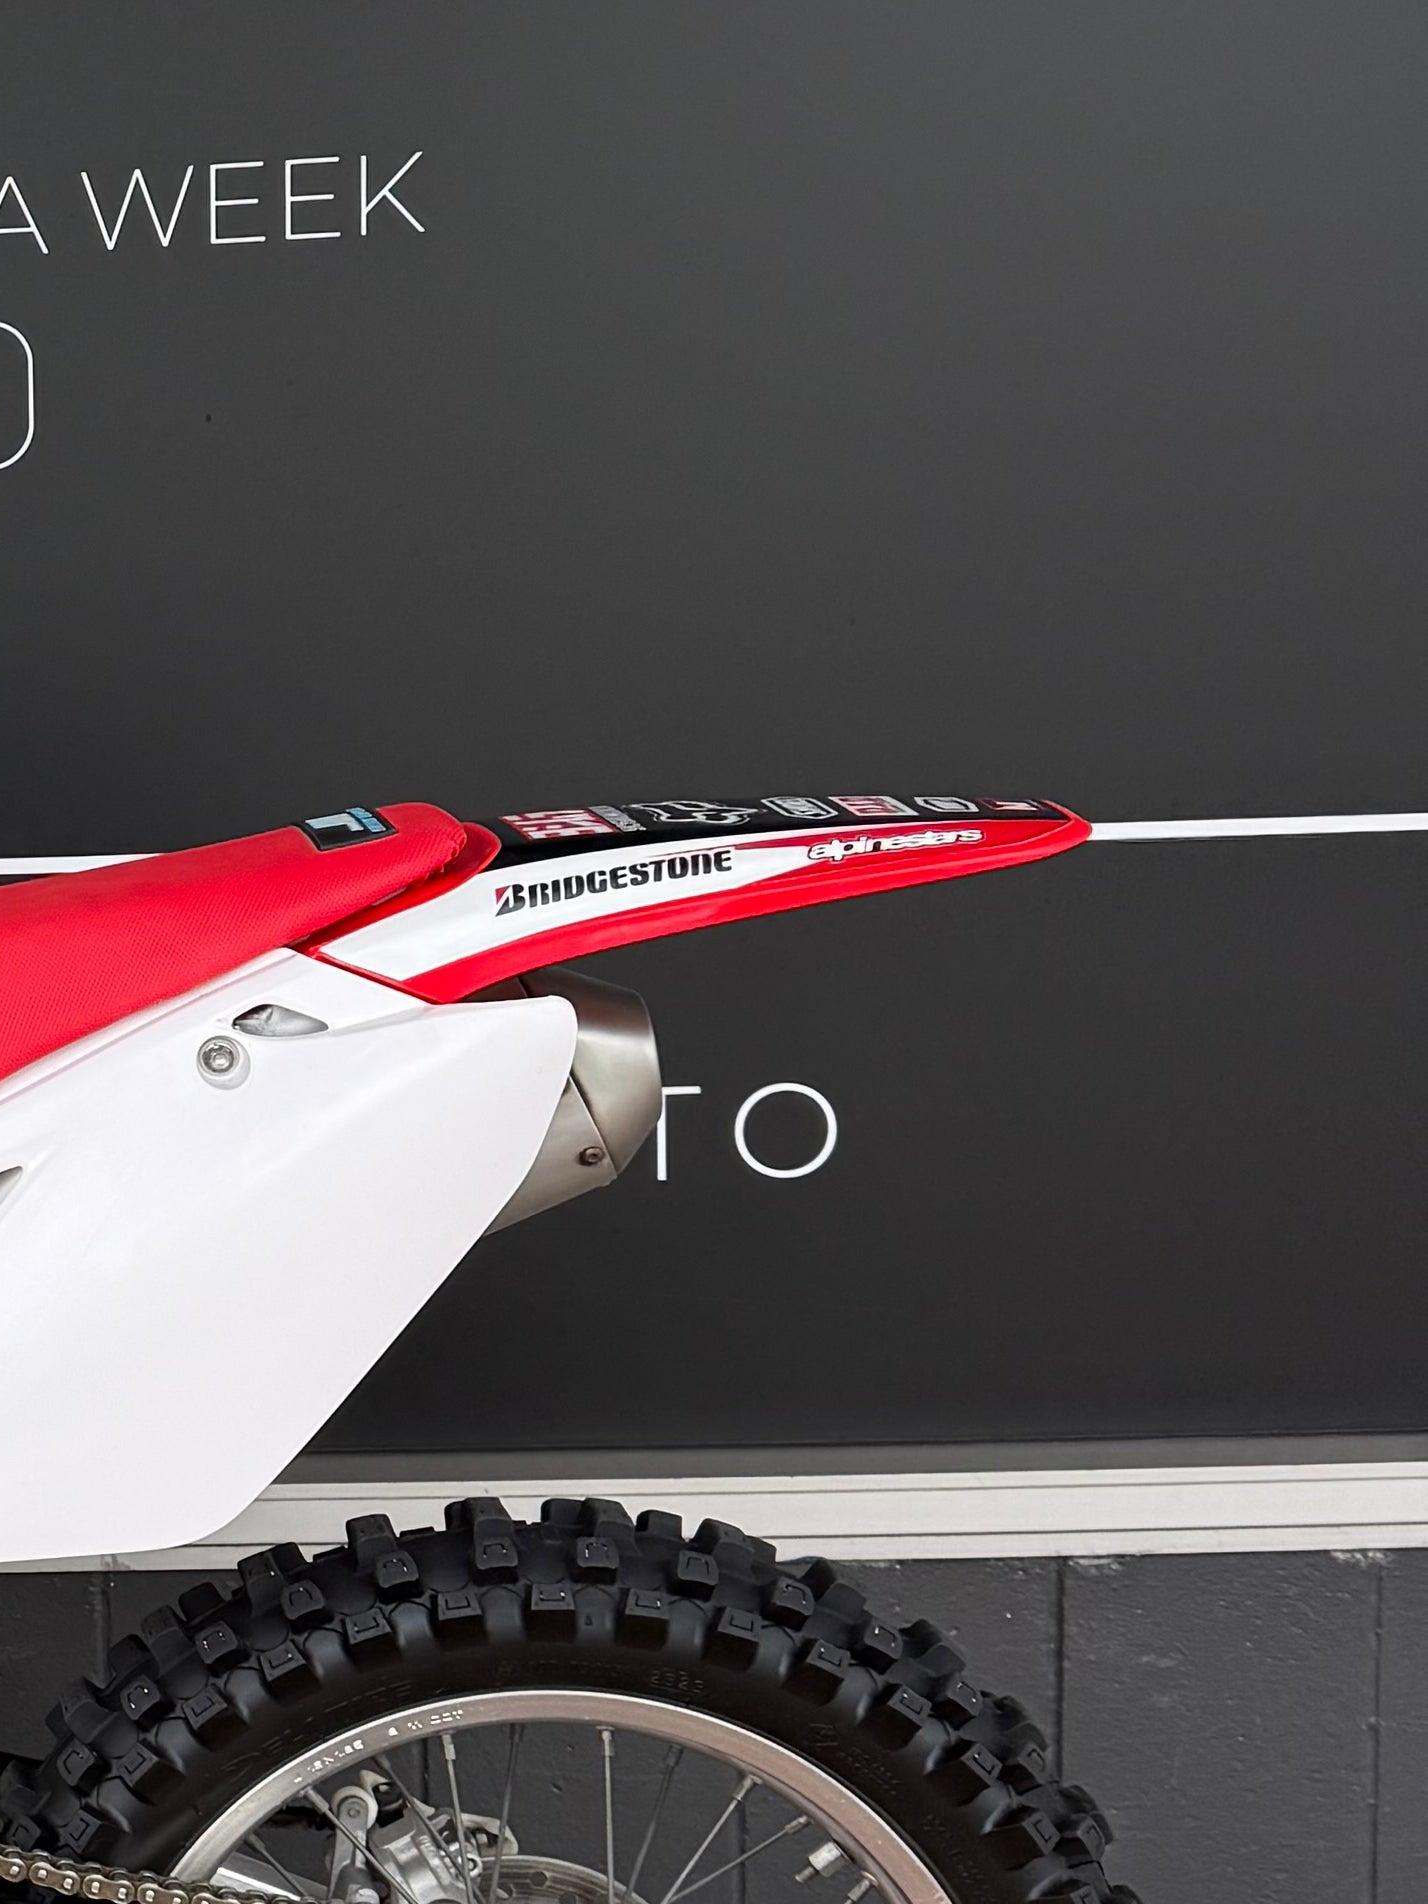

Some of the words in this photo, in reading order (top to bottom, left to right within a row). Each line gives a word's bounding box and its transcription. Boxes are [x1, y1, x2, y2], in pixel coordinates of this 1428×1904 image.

[80, 151, 425, 252] WEEK
[808, 827, 985, 863] alpinestars
[494, 848, 733, 917] BRIDGESTONE
